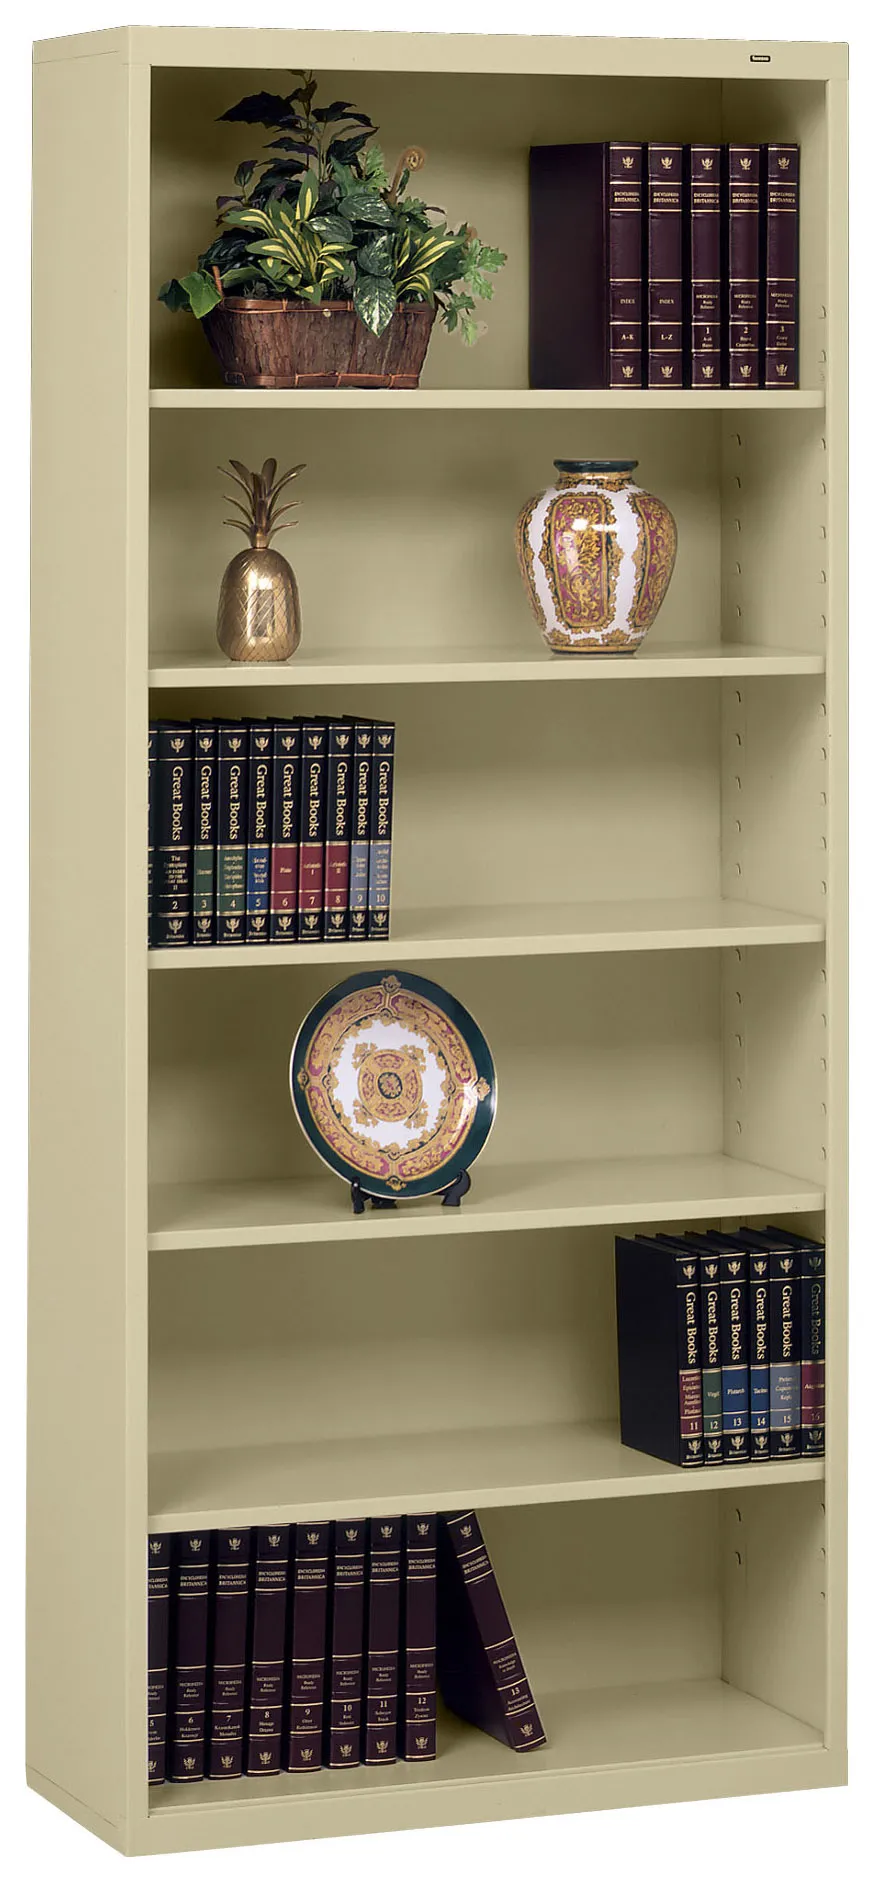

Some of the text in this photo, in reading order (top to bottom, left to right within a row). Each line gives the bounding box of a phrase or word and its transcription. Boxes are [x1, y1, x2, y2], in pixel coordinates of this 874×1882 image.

[173, 766, 183, 840] Great Books
[201, 766, 212, 839] Great Books
[230, 765, 240, 839] Great Books
[256, 764, 267, 838] Great Books
[282, 764, 294, 838] Great Books
[309, 763, 321, 837] Great Books
[336, 762, 348, 836] Great Books
[358, 762, 369, 835] Great Books
[378, 762, 390, 835] Great Books
[172, 901, 178, 910] 2
[201, 900, 207, 908] 3
[255, 898, 261, 906] 5
[282, 898, 288, 906] 6
[309, 896, 315, 905] 7
[686, 1292, 697, 1364] Great Books
[708, 1291, 718, 1363] Great Books
[730, 1288, 741, 1360] Great Books
[756, 1288, 766, 1360] Great Books
[782, 1286, 792, 1357] Great Books
[812, 1284, 821, 1354] Great Books
[690, 1422, 698, 1430] 11
[710, 1421, 718, 1429] 12
[733, 1418, 742, 1426] 13
[757, 1417, 766, 1426] 14
[811, 1412, 820, 1420] 16
[511, 1687, 520, 1696] 13
